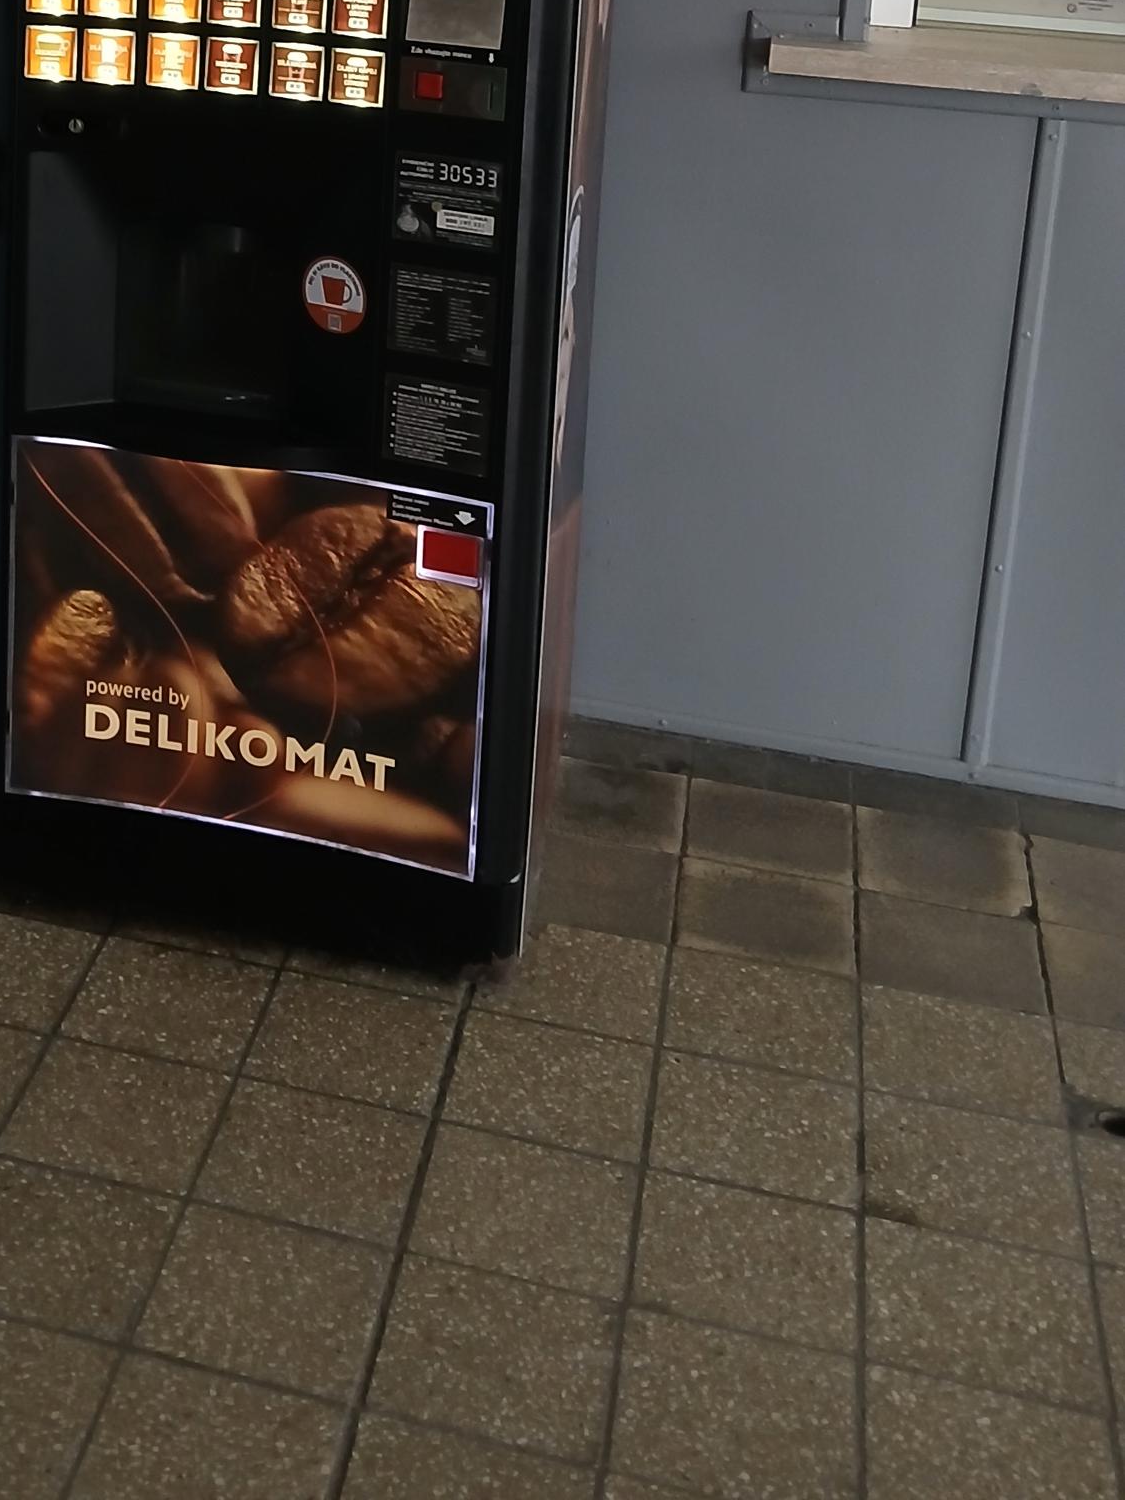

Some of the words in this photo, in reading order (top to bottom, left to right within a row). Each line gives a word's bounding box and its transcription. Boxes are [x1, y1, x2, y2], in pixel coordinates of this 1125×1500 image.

[439, 162, 498, 188] 30533
[86, 679, 163, 703] powered
[168, 688, 190, 710] by
[84, 703, 396, 792] DELIKOMAT
